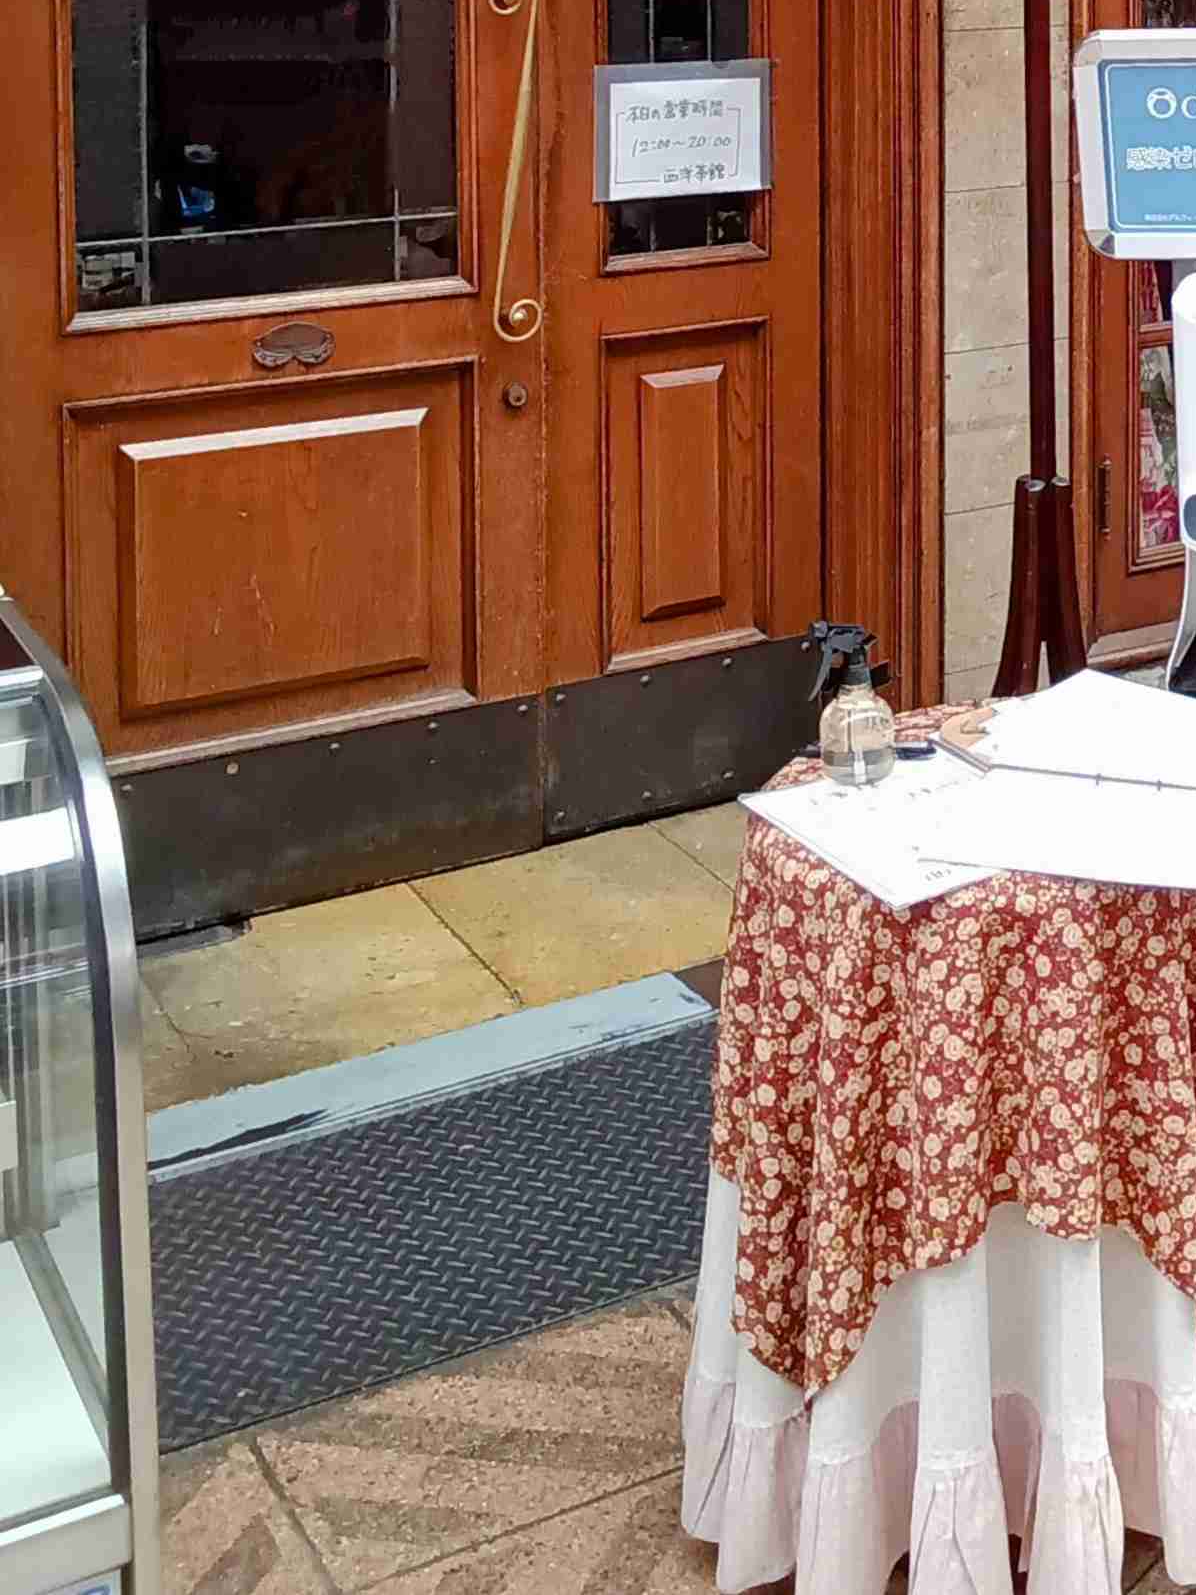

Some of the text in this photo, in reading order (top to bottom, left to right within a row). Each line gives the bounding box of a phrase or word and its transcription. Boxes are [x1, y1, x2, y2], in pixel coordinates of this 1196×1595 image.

[625, 99, 723, 124] 本日の営業時間
